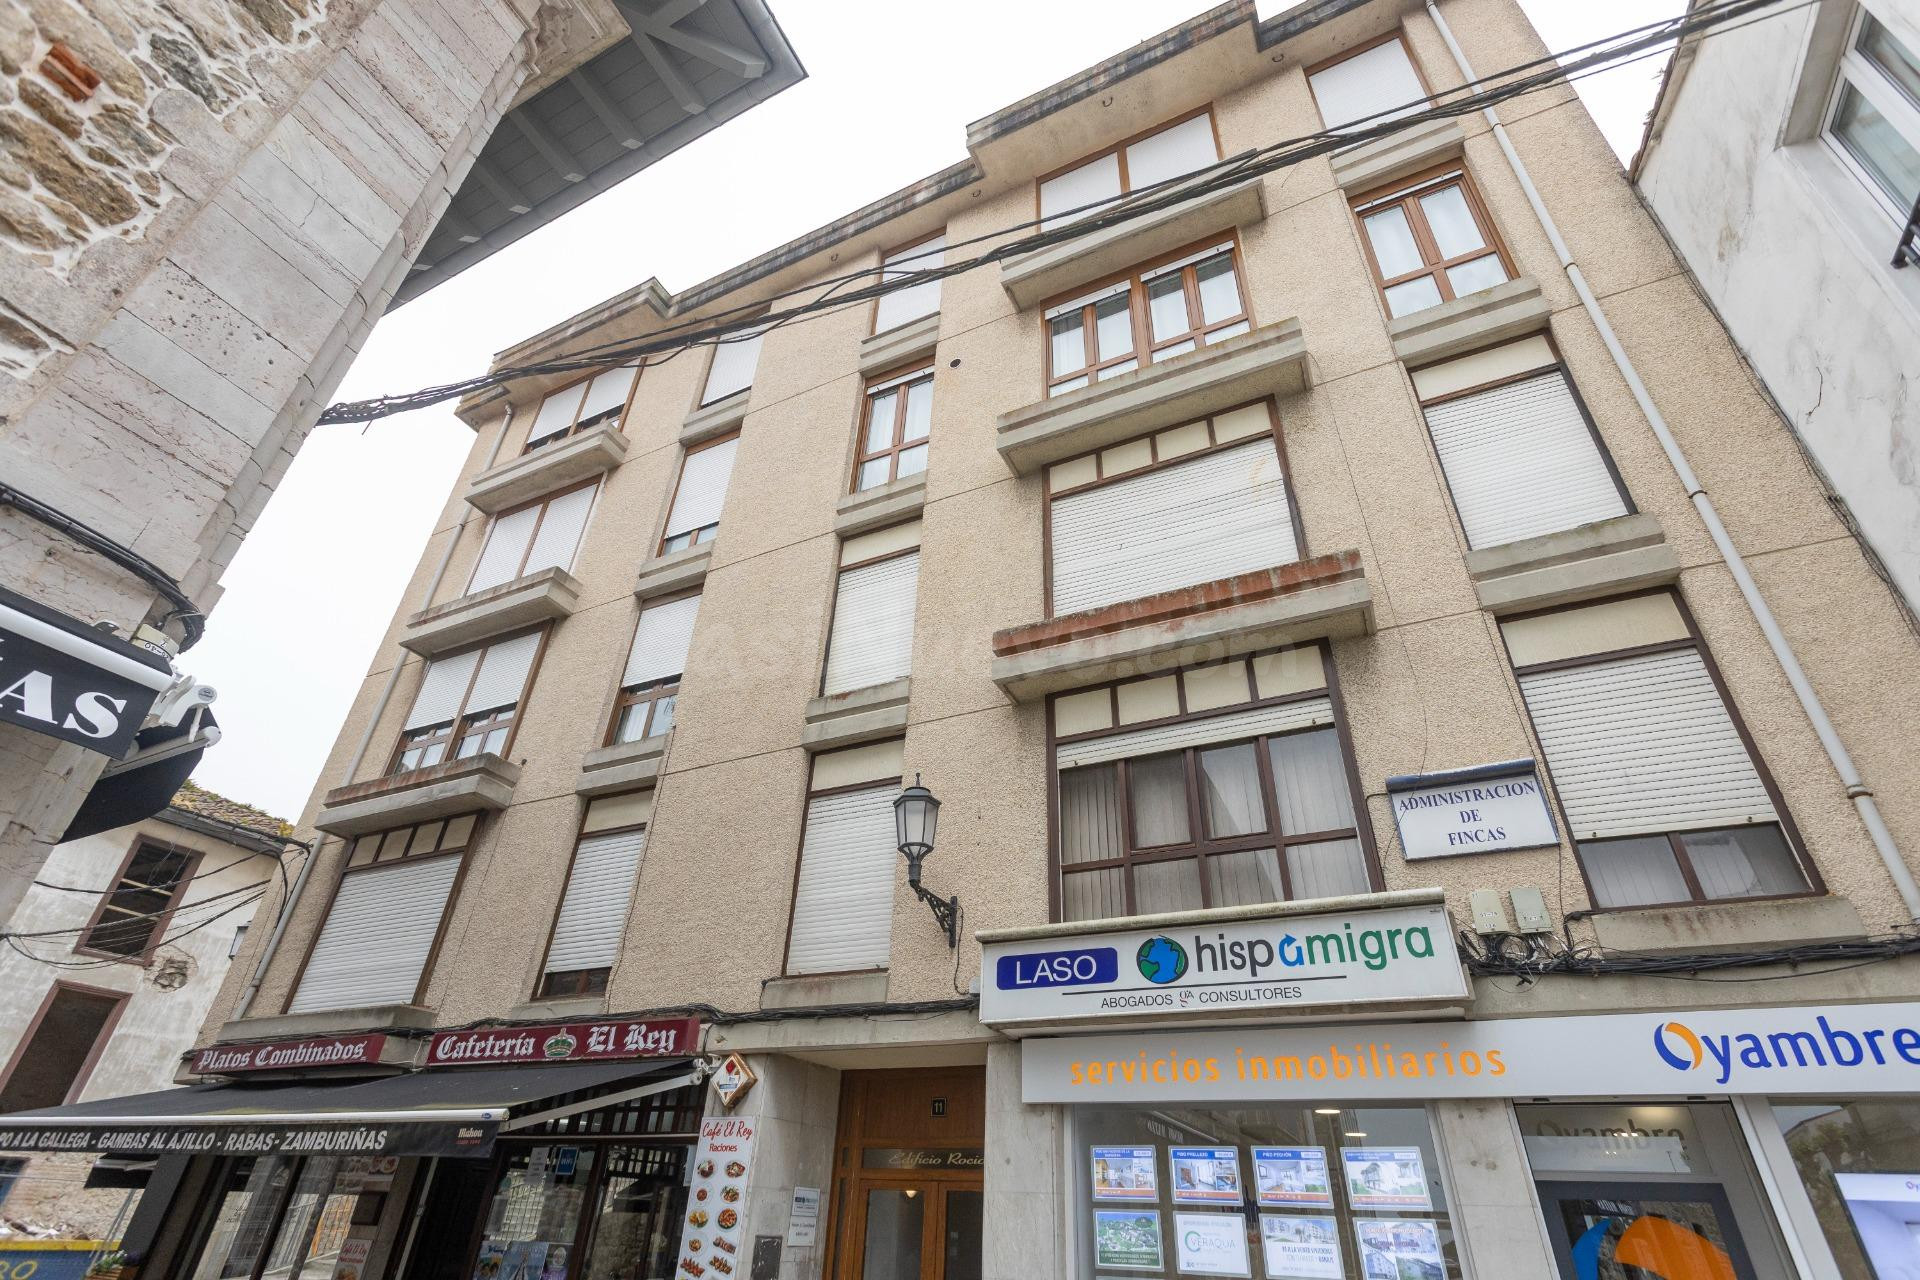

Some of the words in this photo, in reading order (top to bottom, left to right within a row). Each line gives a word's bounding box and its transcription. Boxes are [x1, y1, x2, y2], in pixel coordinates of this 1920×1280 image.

[1399, 781, 1535, 811] ADMINISTRACION
[1460, 809, 1482, 823] DE
[1448, 827, 1506, 846] FINCAS
[1195, 923, 1435, 977] hispamigra
[1015, 955, 1097, 984] LASO
[1101, 994, 1173, 1009] ABOGADOS
[1200, 987, 1301, 1003] CONSULTORES
[436, 1032, 536, 1060] Cafetería
[588, 1024, 617, 1052] El
[624, 1023, 677, 1054] Rey
[1654, 1016, 1920, 1084] Oyambre
[198, 1049, 253, 1070] Platos
[255, 1041, 367, 1067] Combinados
[1071, 1049, 1221, 1085] servicios
[1235, 1041, 1506, 1081] inmobiliarios
[934, 1102, 943, 1113] 11
[12, 1132, 22, 1148] A
[21, 1132, 39, 1148] LA
[38, 1132, 91, 1149] GALLEGA
[98, 1132, 151, 1149] GAMBAS
[150, 1132, 166, 1149] AL
[166, 1132, 216, 1150] AJILLO
[280, 1127, 387, 1150] ZAMBURIÑAS
[703, 1122, 722, 1140] Café
[724, 1121, 735, 1137] El
[736, 1121, 752, 1140] Rey
[709, 1143, 737, 1152] Raciones
[889, 1152, 942, 1167] Edificio
